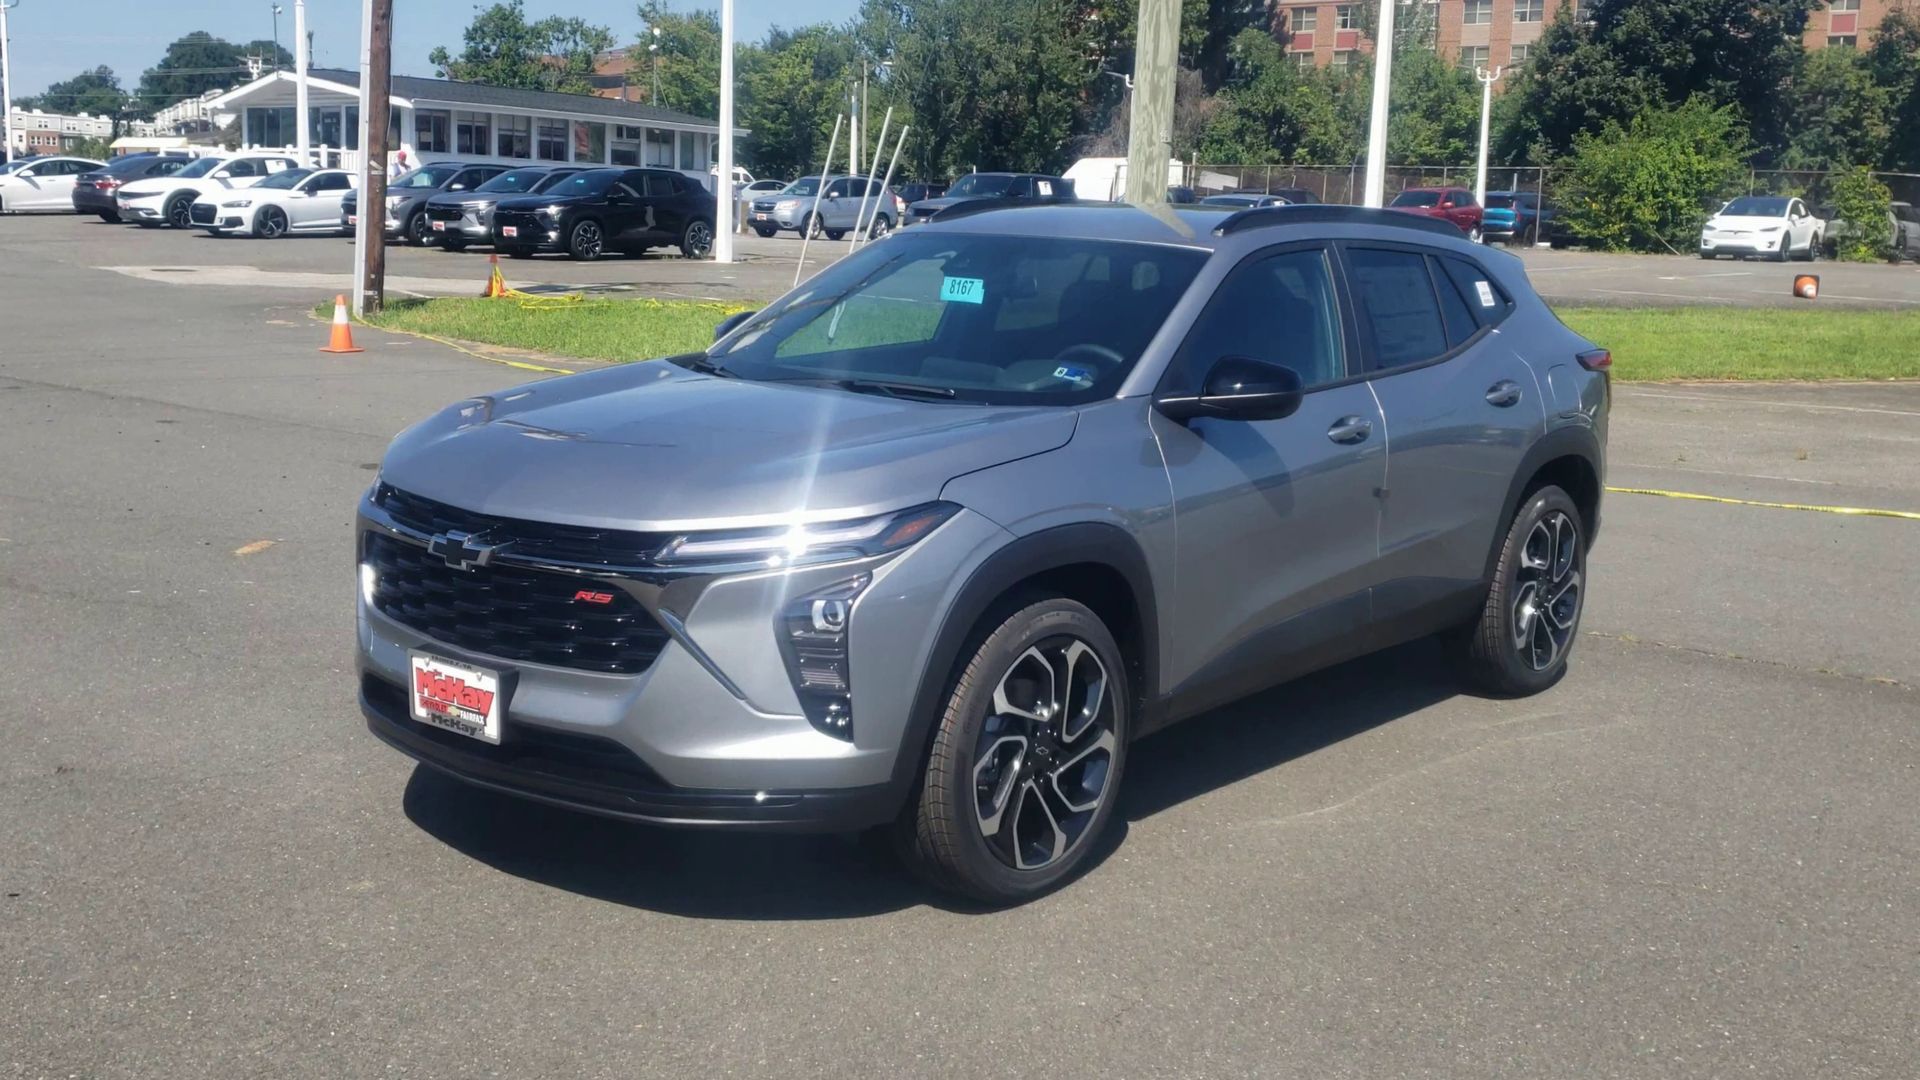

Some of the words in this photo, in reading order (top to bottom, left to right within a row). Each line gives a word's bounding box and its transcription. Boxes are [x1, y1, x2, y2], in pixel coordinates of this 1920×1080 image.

[949, 279, 974, 294] 8167
[574, 590, 614, 604] RS
[415, 667, 494, 716] McKay
[431, 713, 477, 735] McKay
